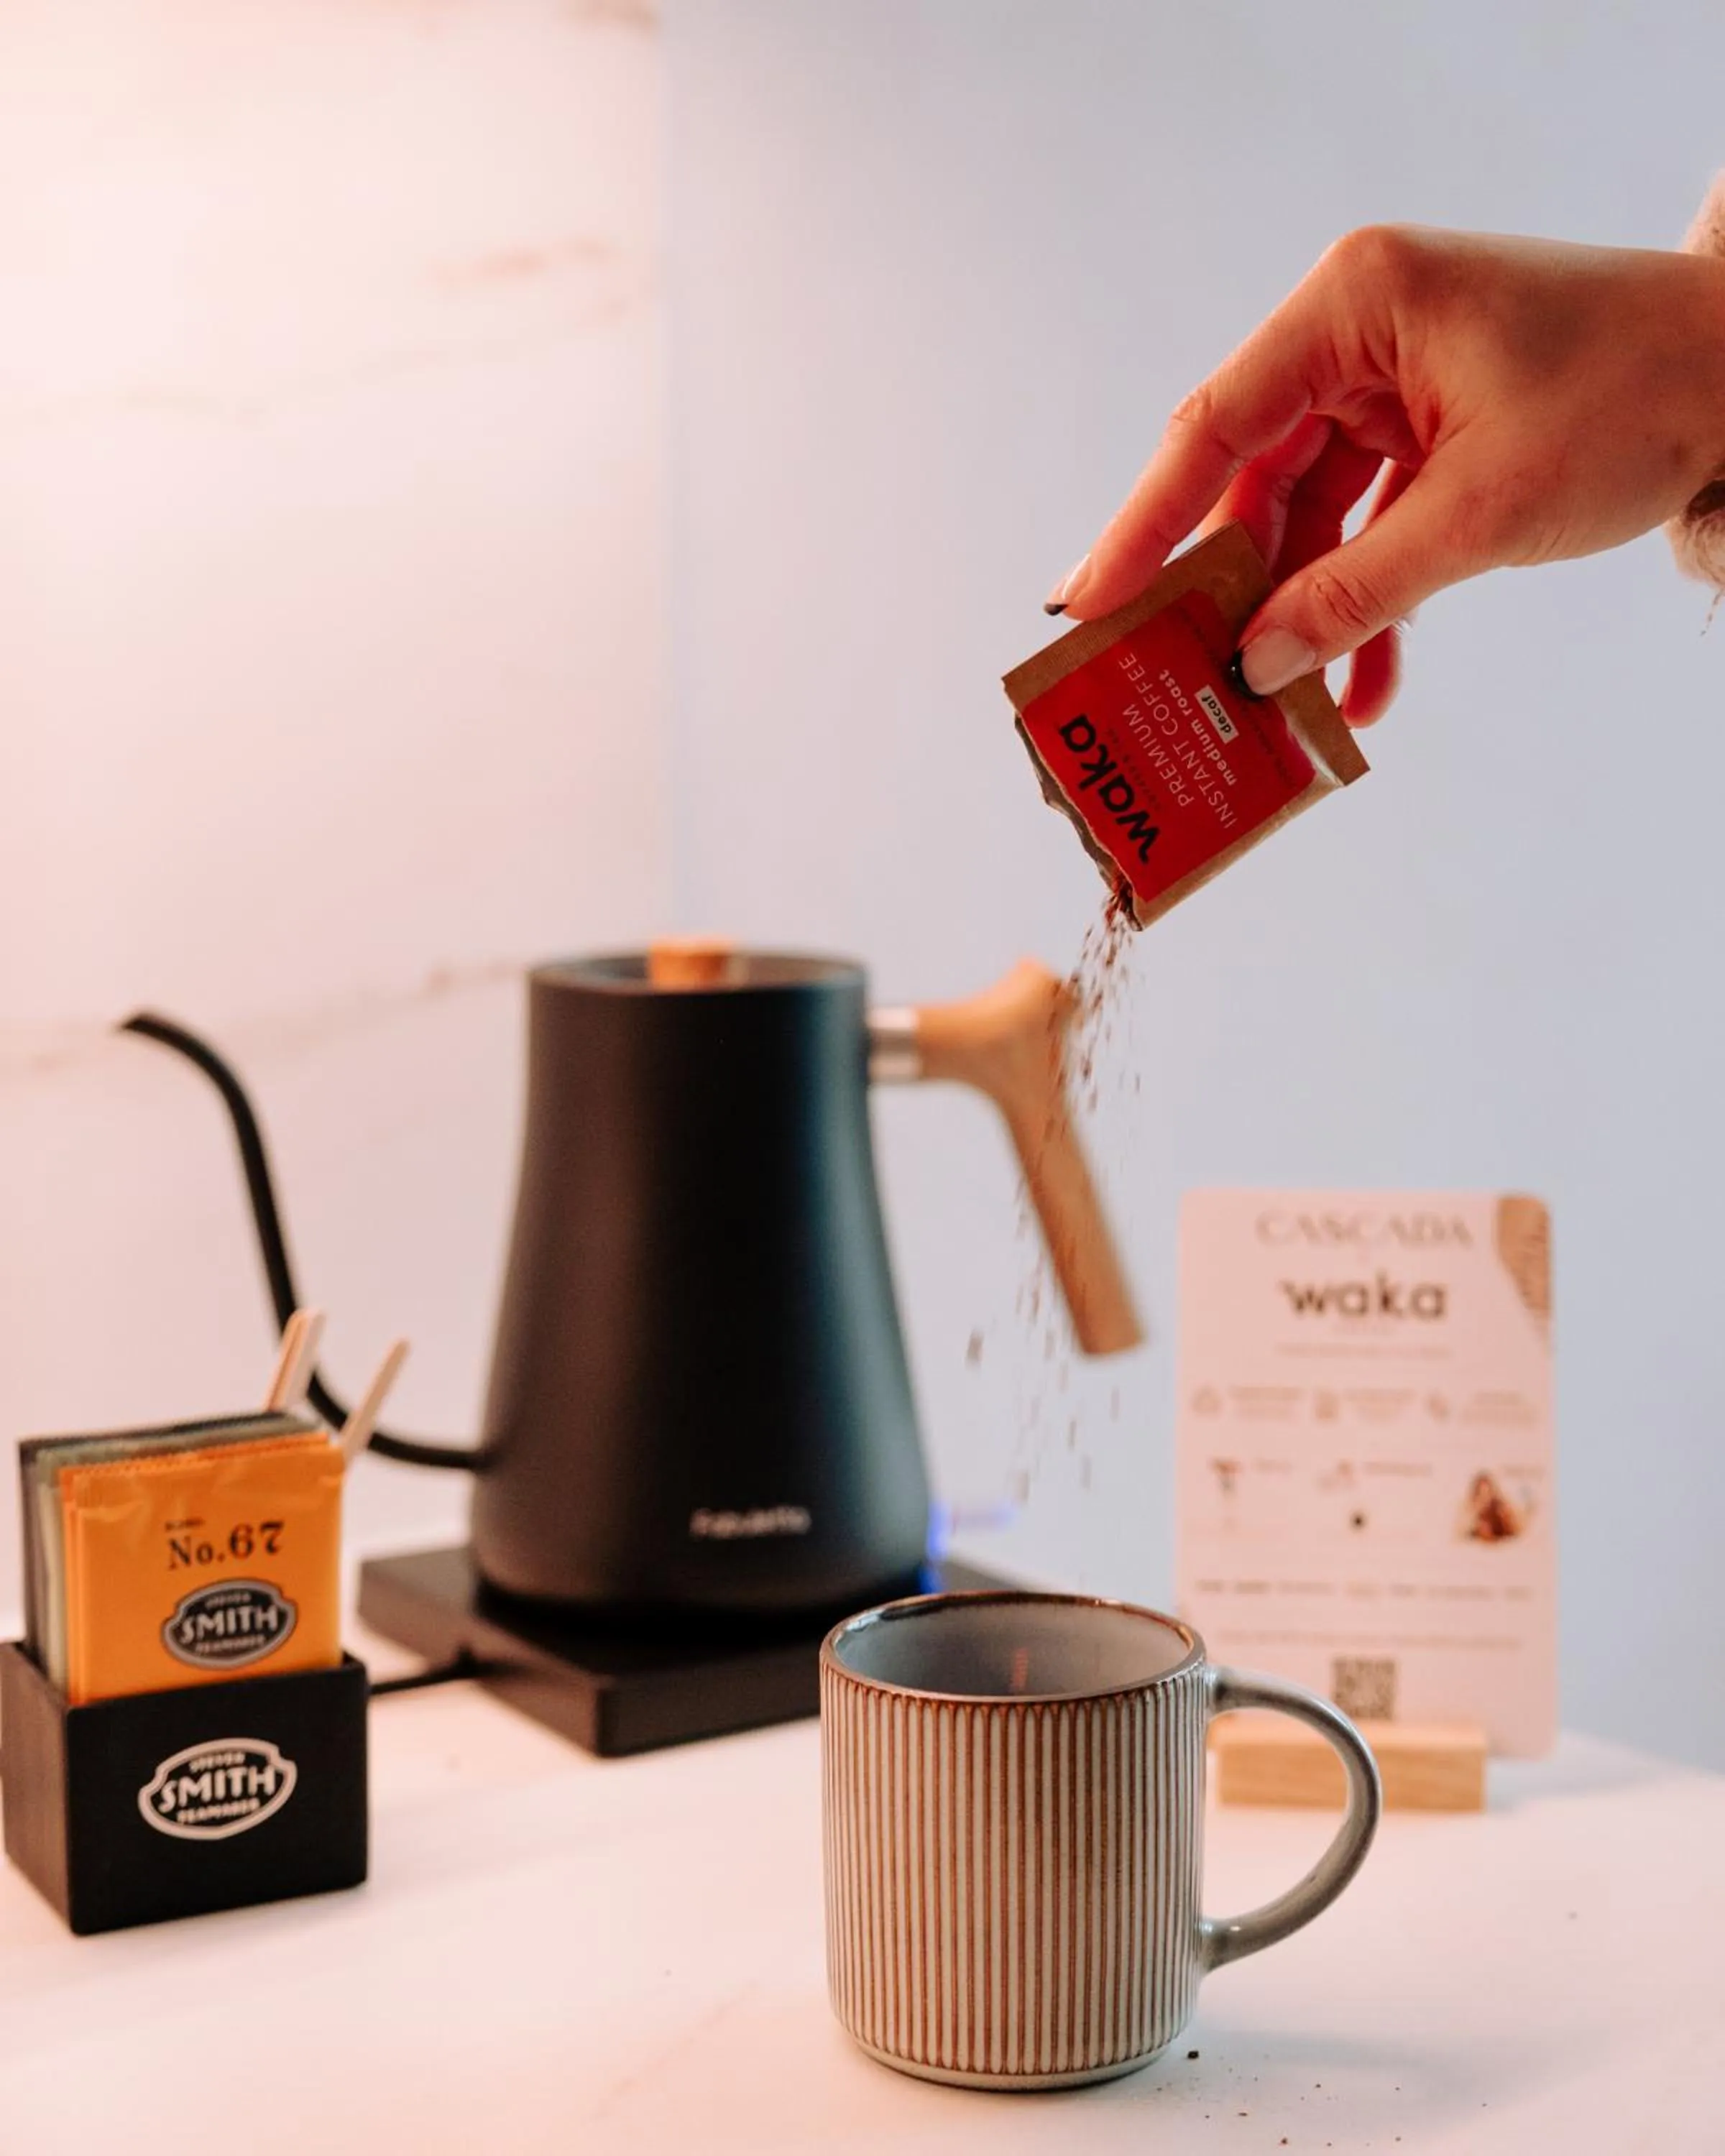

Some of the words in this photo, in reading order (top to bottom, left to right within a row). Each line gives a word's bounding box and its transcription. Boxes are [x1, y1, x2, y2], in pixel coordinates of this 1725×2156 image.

[1118, 652, 1179, 735] COFFEE
[1159, 668, 1193, 717] roast
[1201, 694, 1232, 734] decaf
[1122, 703, 1195, 806] PREMIUM
[1190, 718, 1237, 786] medium
[1059, 714, 1159, 864] waka
[1171, 740, 1238, 829] INSTANT
[1277, 1268, 1450, 1321] waka
[180, 1603, 279, 1645] SMITH
[157, 1764, 276, 1814] SMITH
